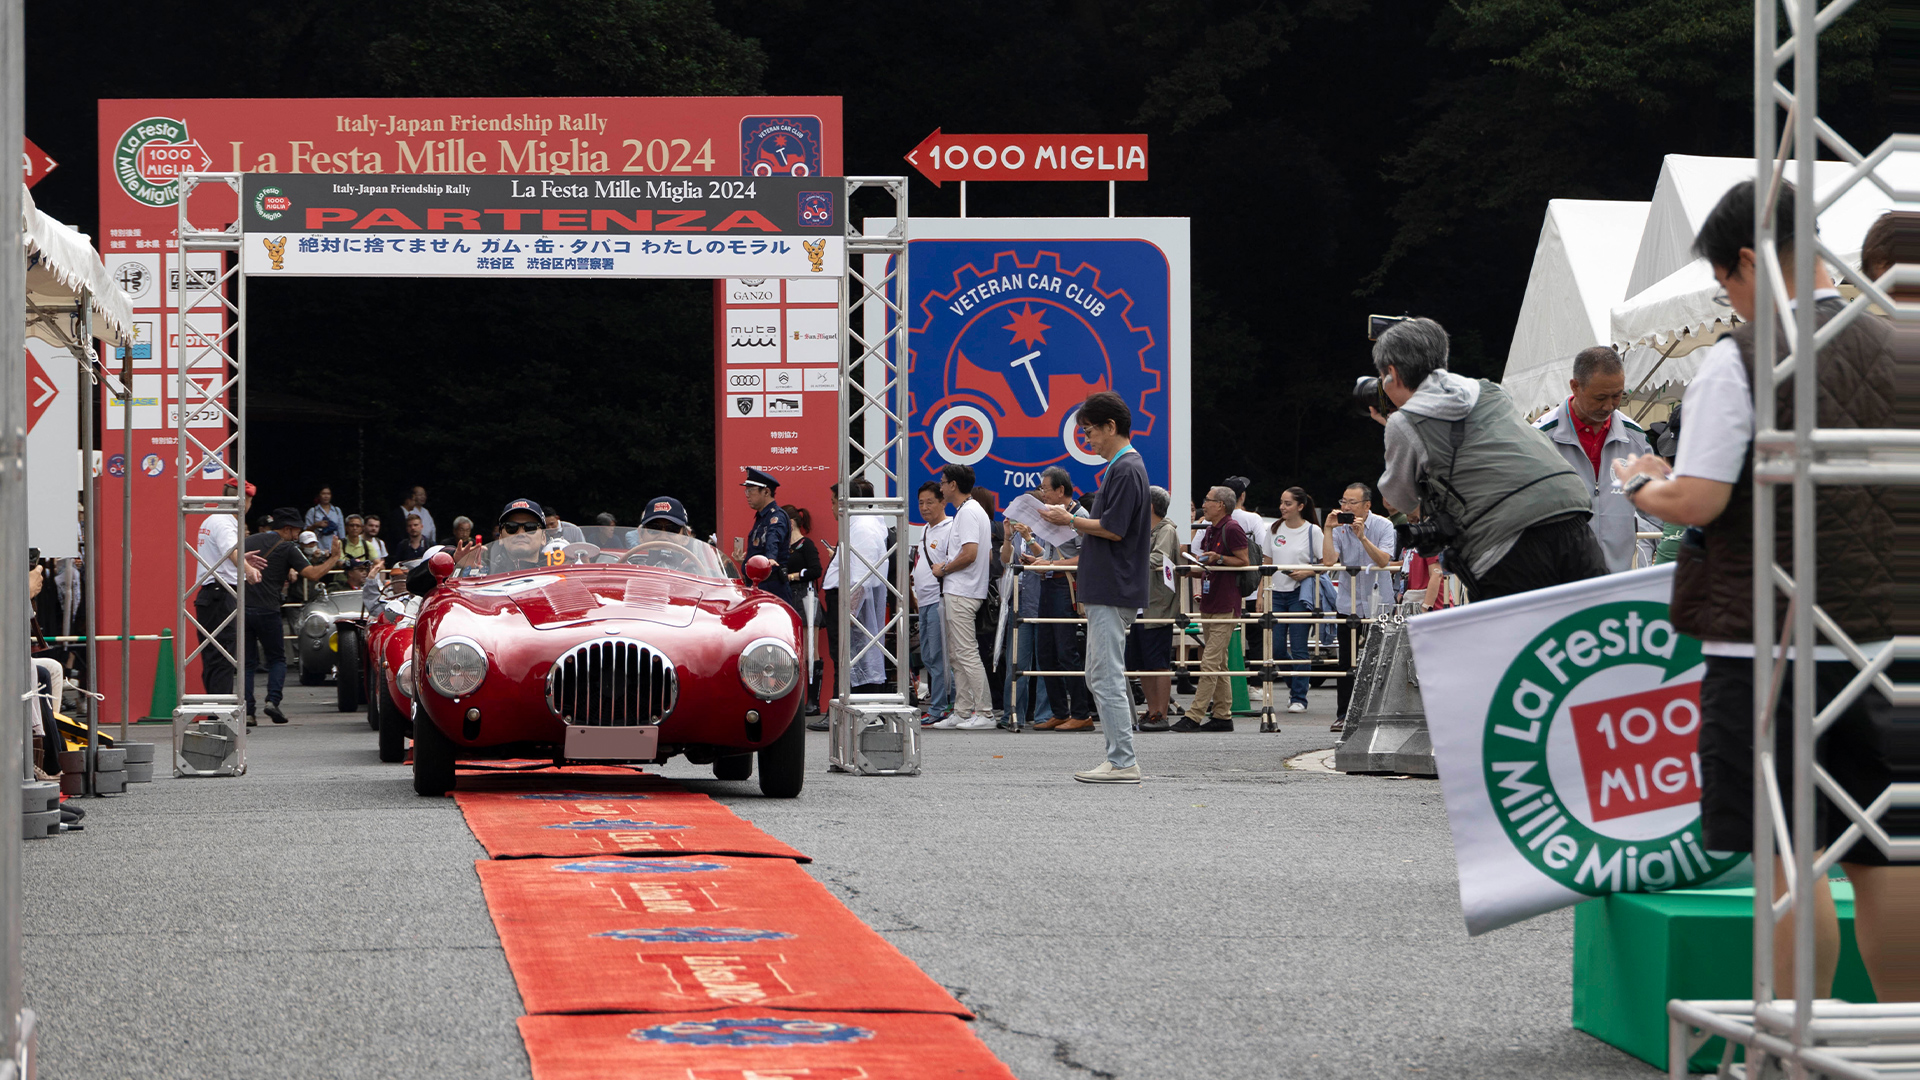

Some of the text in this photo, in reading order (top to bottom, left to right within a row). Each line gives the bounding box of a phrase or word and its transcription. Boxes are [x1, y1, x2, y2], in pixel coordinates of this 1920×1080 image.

[337, 113, 608, 136] Italy-Japan Friendship Rally
[758, 125, 780, 139] VETERAN
[791, 128, 804, 139] CLUB
[121, 123, 179, 154] La Festa
[149, 149, 192, 161] 1000
[229, 138, 716, 175] La Festa Mille Miglia 2024
[929, 144, 1146, 170] 1000 MIGLIA
[118, 156, 139, 191] Mille
[332, 183, 471, 196] Italy-Japan Friendship Rally
[511, 180, 757, 203] La Festa Mille Miglia 2024
[305, 207, 783, 232] PARTENZA
[298, 237, 791, 254] 絶対に捨てません ガム・缶・タバコ わたしのモラル
[476, 257, 614, 270] 渋谷区 渋谷区内警察署
[733, 291, 773, 300] GANZO
[949, 273, 1106, 318] VETERAN CAR CLUB
[730, 325, 776, 334] muta
[544, 549, 566, 567] 19
[1493, 611, 1681, 743] La Festa
[1491, 760, 1579, 870] Mille
